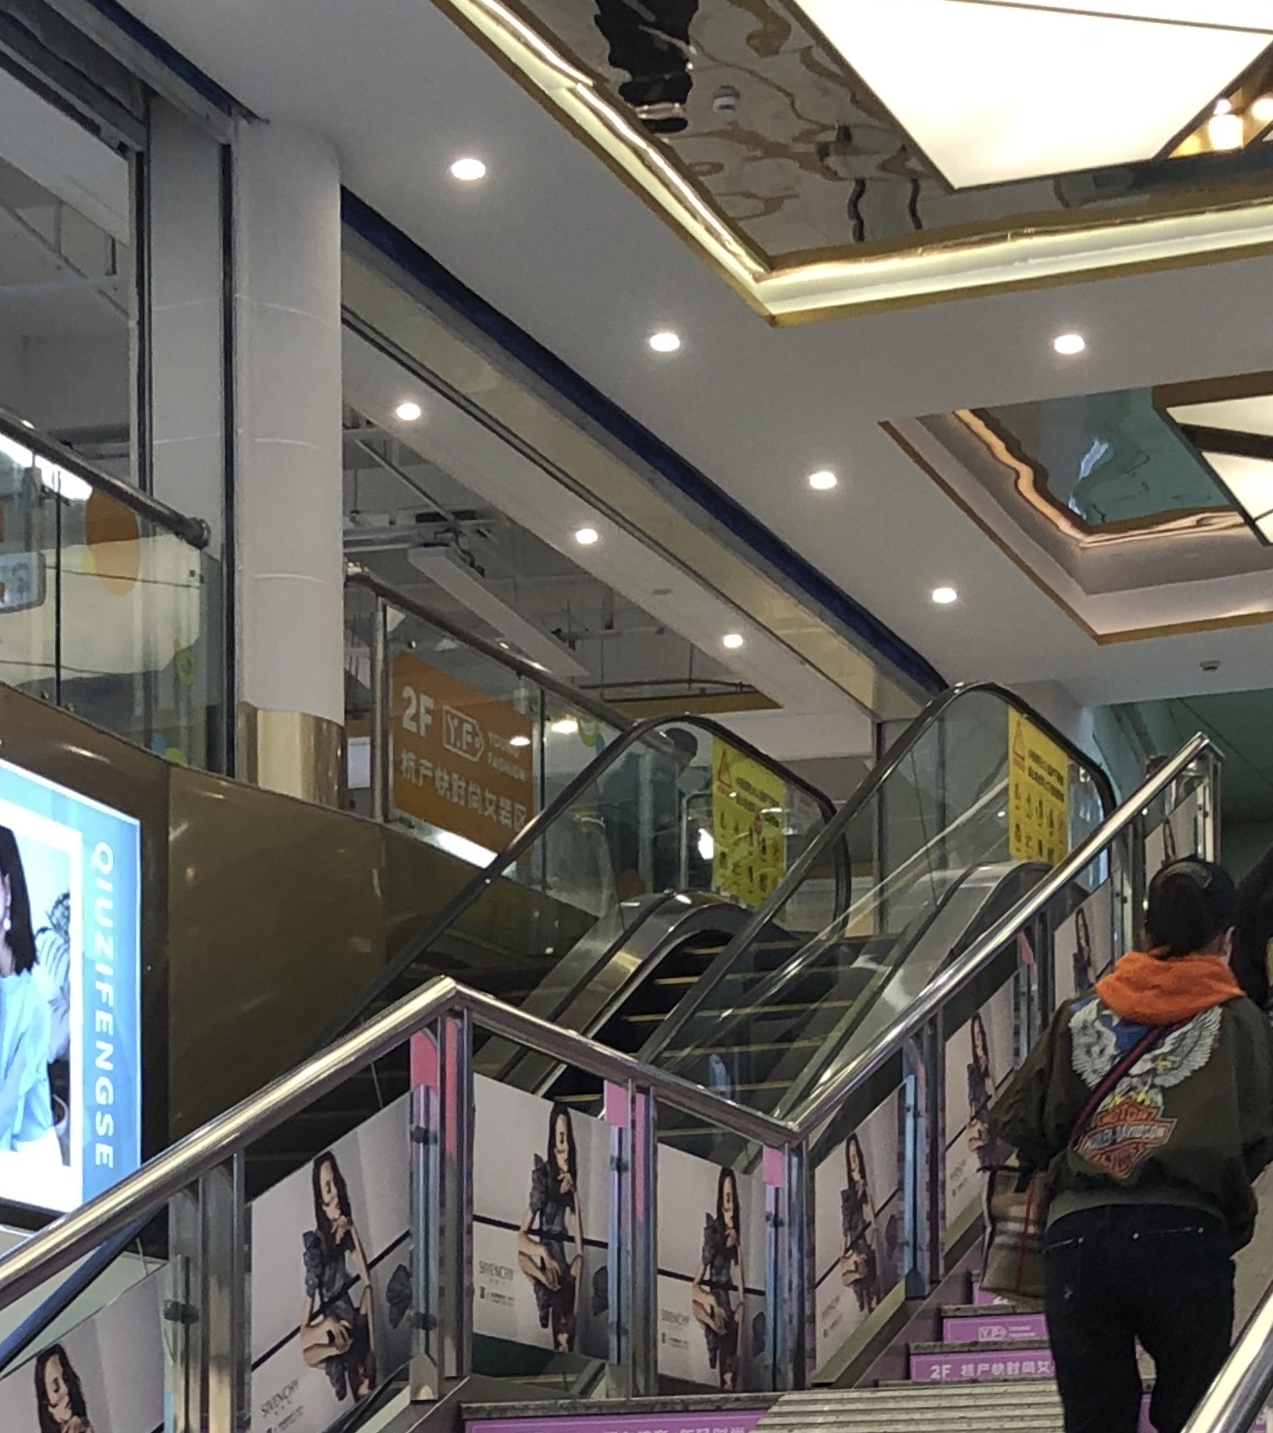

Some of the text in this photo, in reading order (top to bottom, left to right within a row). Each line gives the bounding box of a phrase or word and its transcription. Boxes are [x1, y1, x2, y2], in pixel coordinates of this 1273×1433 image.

[402, 686, 435, 737] 2F
[401, 749, 528, 832] 杭产快时尚女装区
[93, 840, 114, 1169] QIUZIFENGSE
[931, 1364, 951, 1378] 2F
